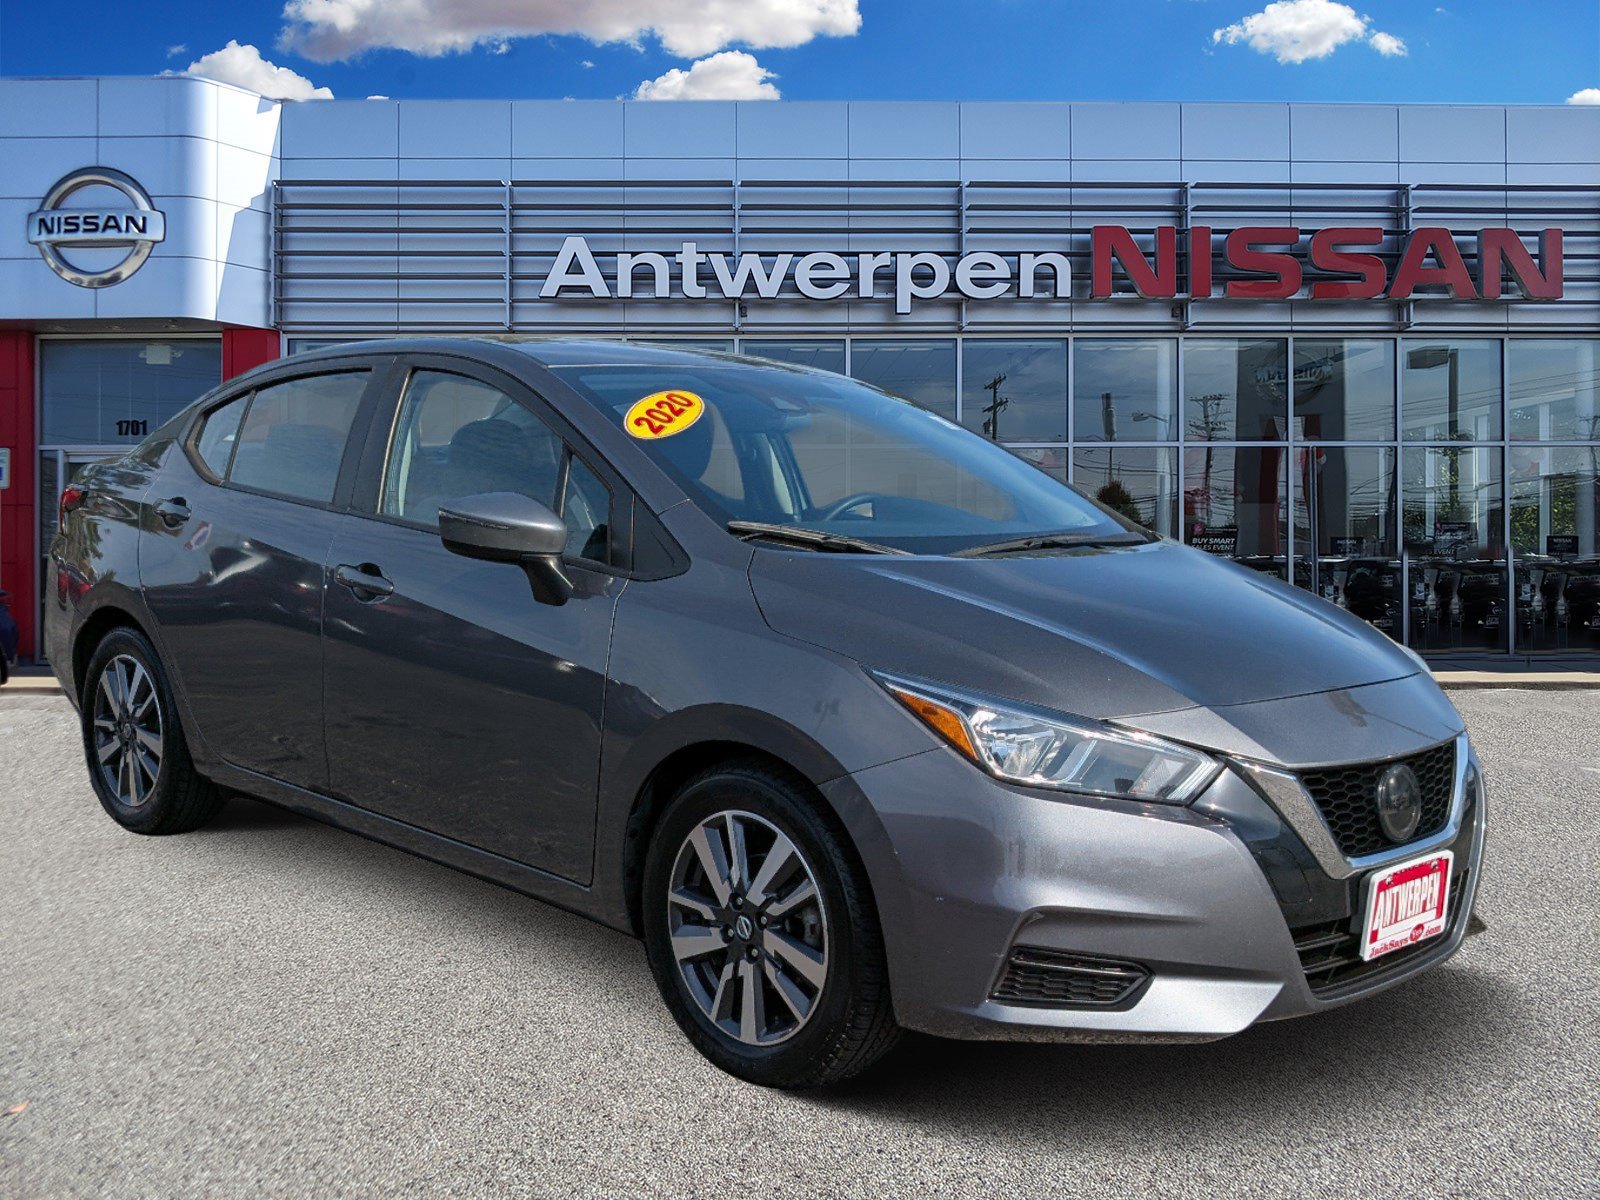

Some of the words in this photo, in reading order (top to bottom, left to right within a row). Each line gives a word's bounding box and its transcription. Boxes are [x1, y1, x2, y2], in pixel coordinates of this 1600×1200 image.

[38, 215, 147, 235] NISSAN
[538, 235, 1073, 315] Antwerpen
[1090, 225, 1564, 300] NISSAN
[116, 420, 147, 436] 1701
[634, 393, 694, 435] 2020
[1372, 871, 1441, 929] ANTWERPEN
